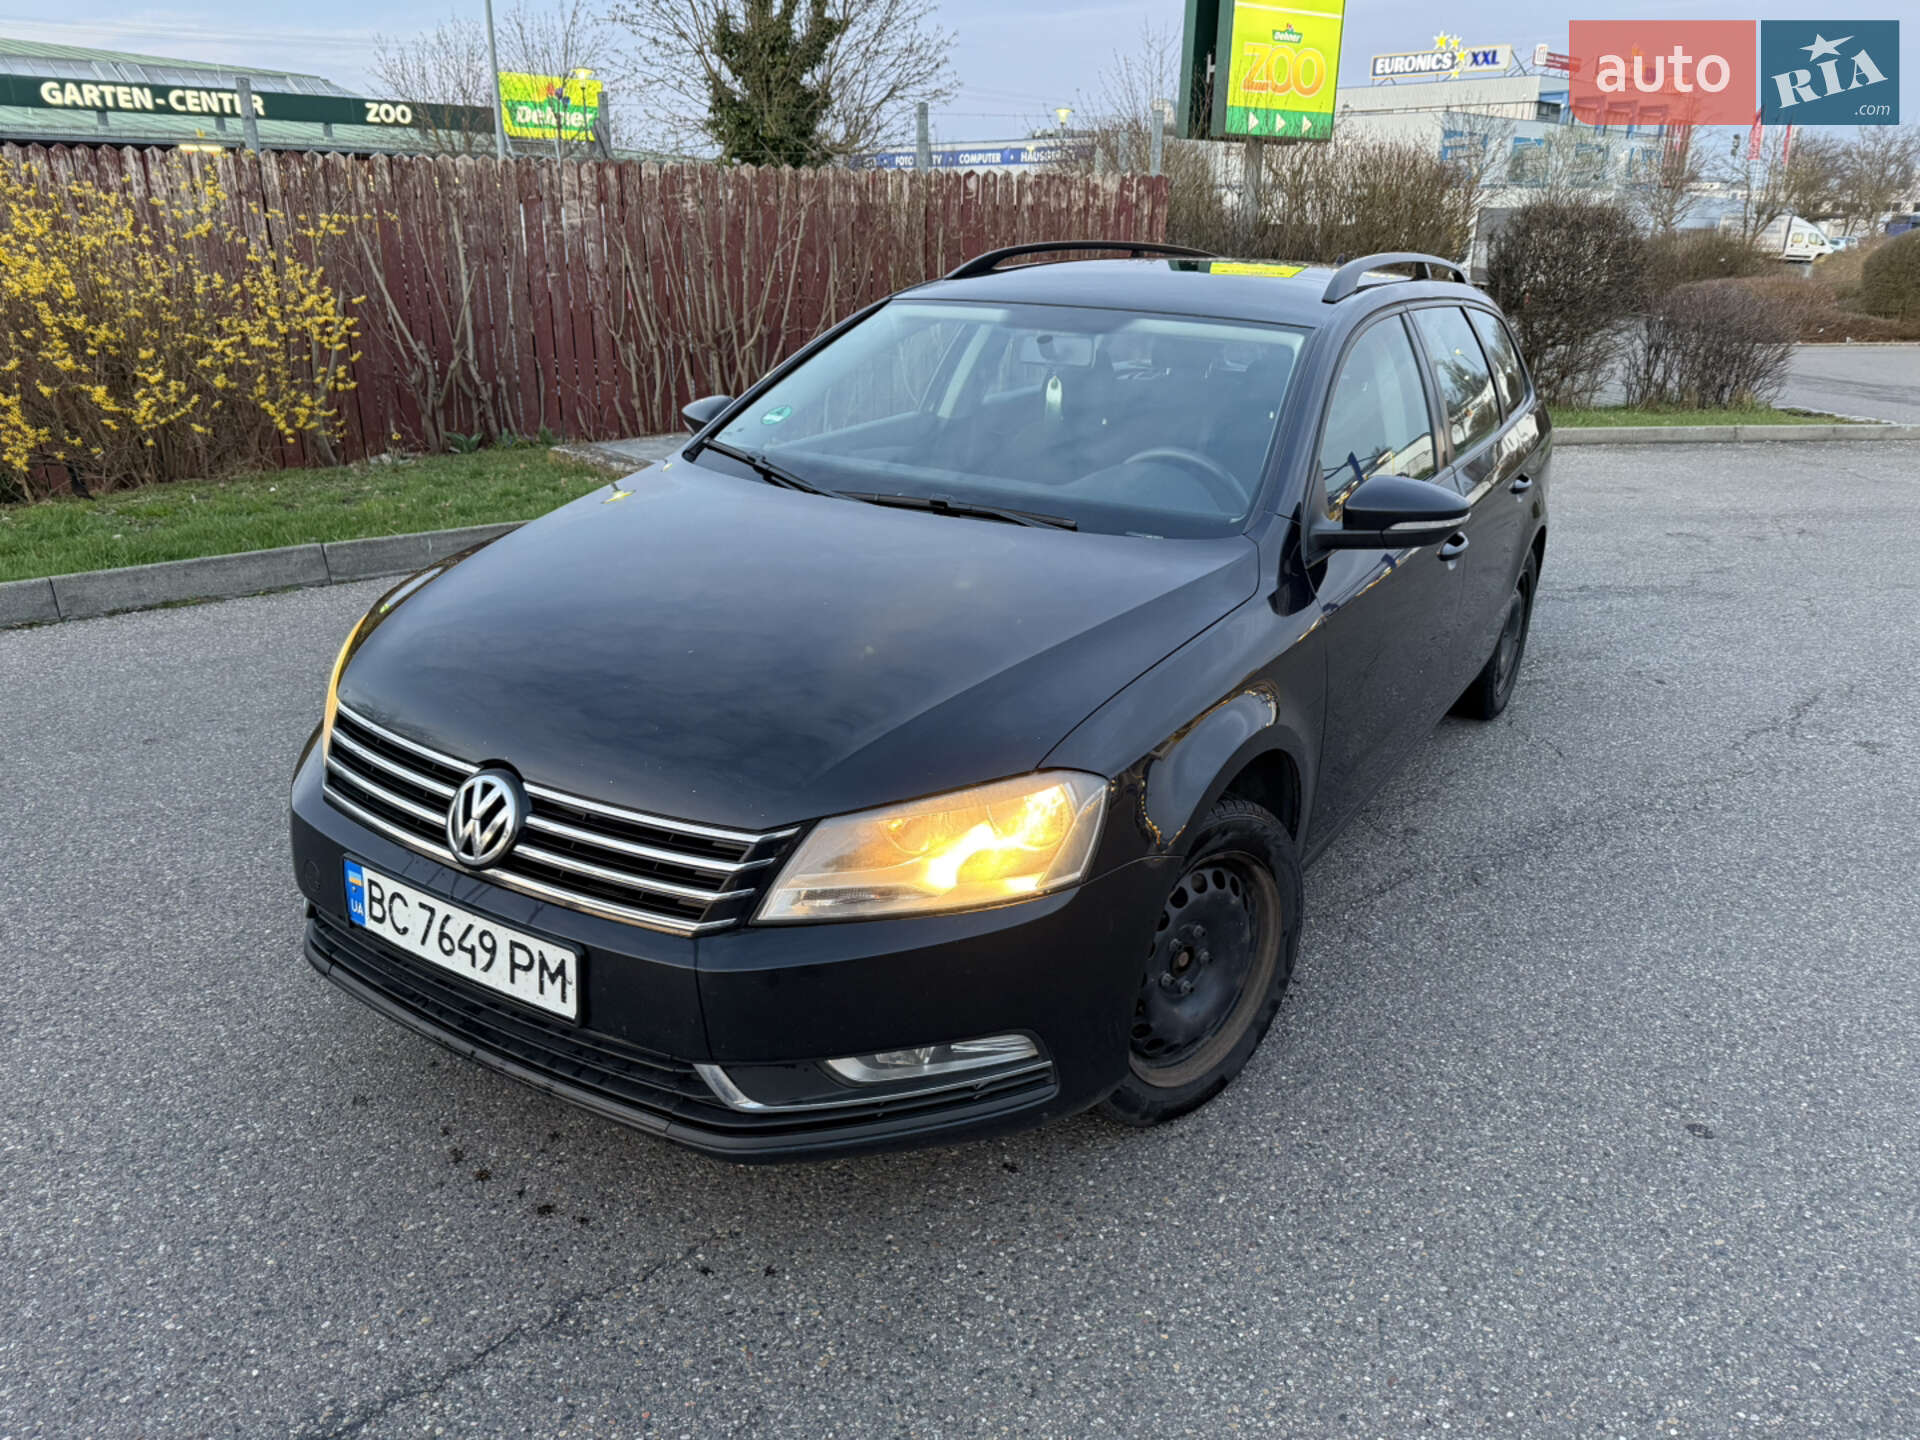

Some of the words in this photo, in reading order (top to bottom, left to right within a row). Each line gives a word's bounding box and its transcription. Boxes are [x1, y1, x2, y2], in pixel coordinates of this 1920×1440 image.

[1243, 42, 1327, 98] ZOO
[1375, 53, 1453, 75] EURONICS
[1470, 50, 1500, 66] XXL
[364, 102, 412, 124] ZOO
[895, 156, 913, 166] FOTO
[958, 152, 1002, 164] COMPUTER
[351, 898, 363, 916] UA
[418, 902, 498, 973] 7649
[508, 939, 568, 1004] PM
